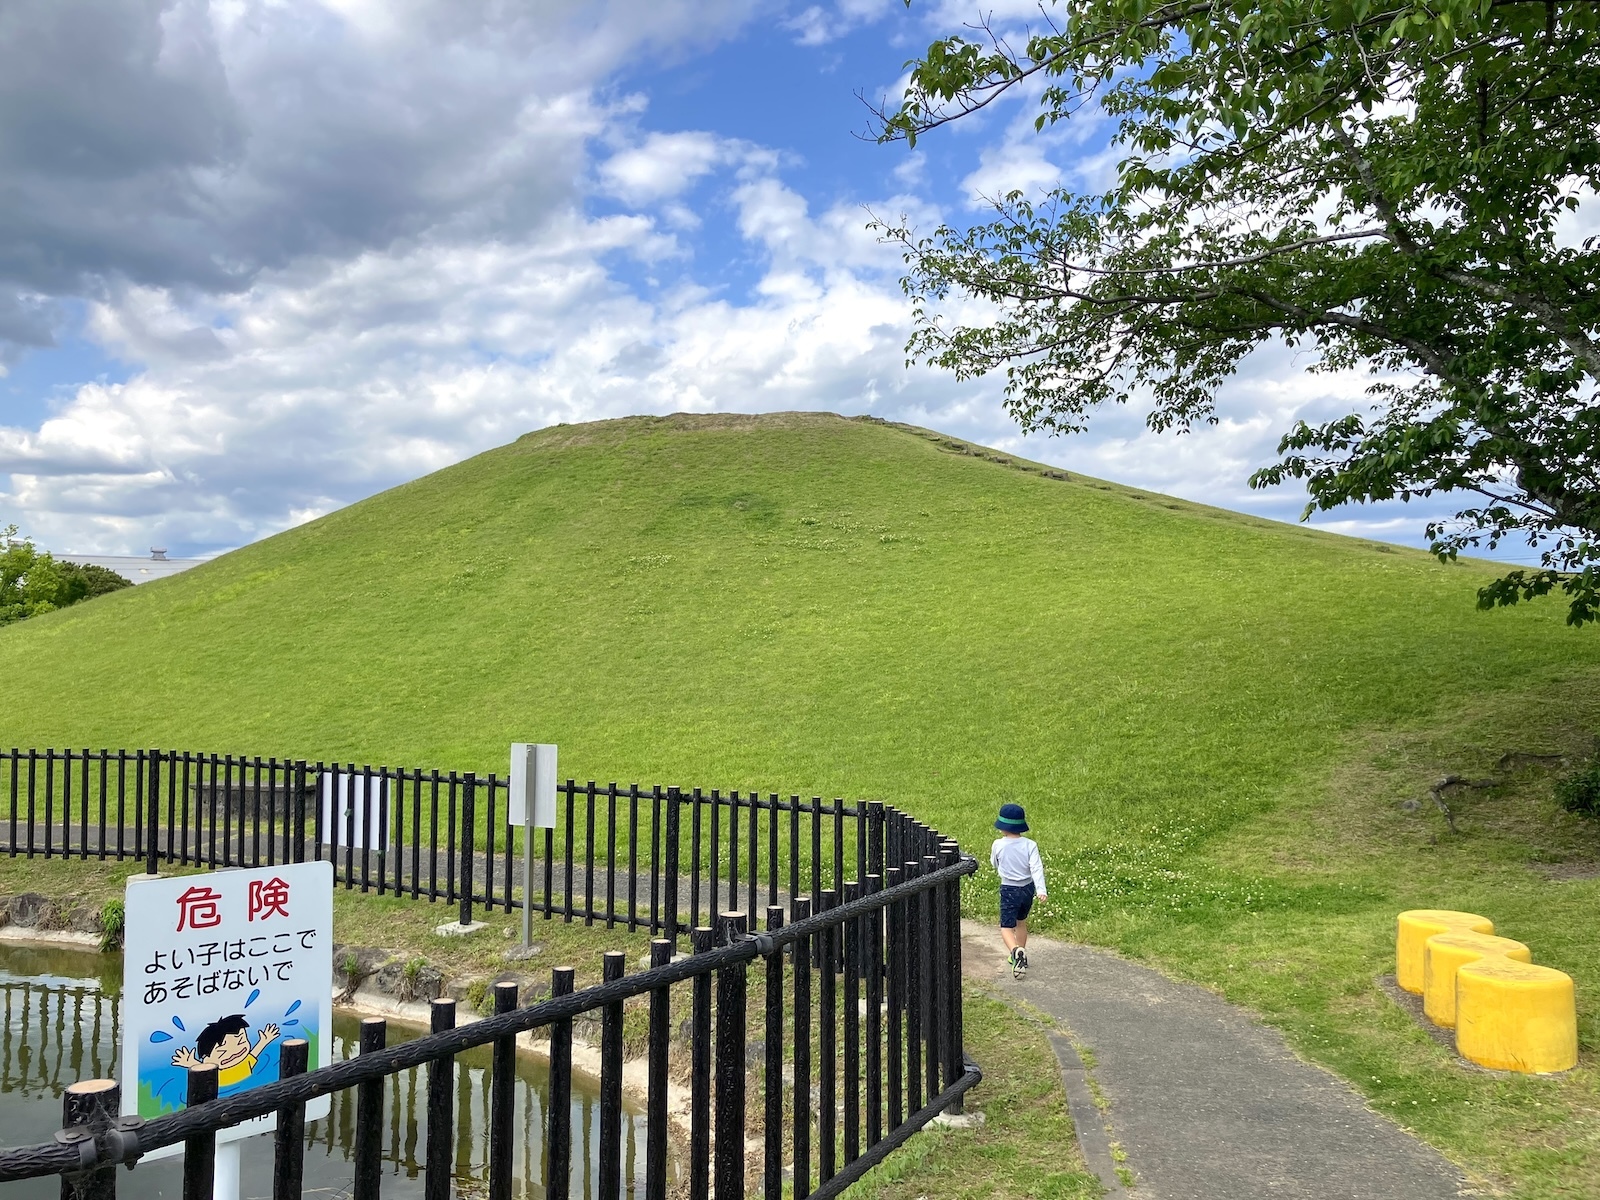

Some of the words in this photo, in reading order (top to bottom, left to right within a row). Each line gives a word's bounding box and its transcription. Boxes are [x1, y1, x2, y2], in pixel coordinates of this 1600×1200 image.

[176, 877, 290, 932] 危険
[144, 929, 317, 974] よい子はここで
[143, 960, 293, 1005] あそばないで
